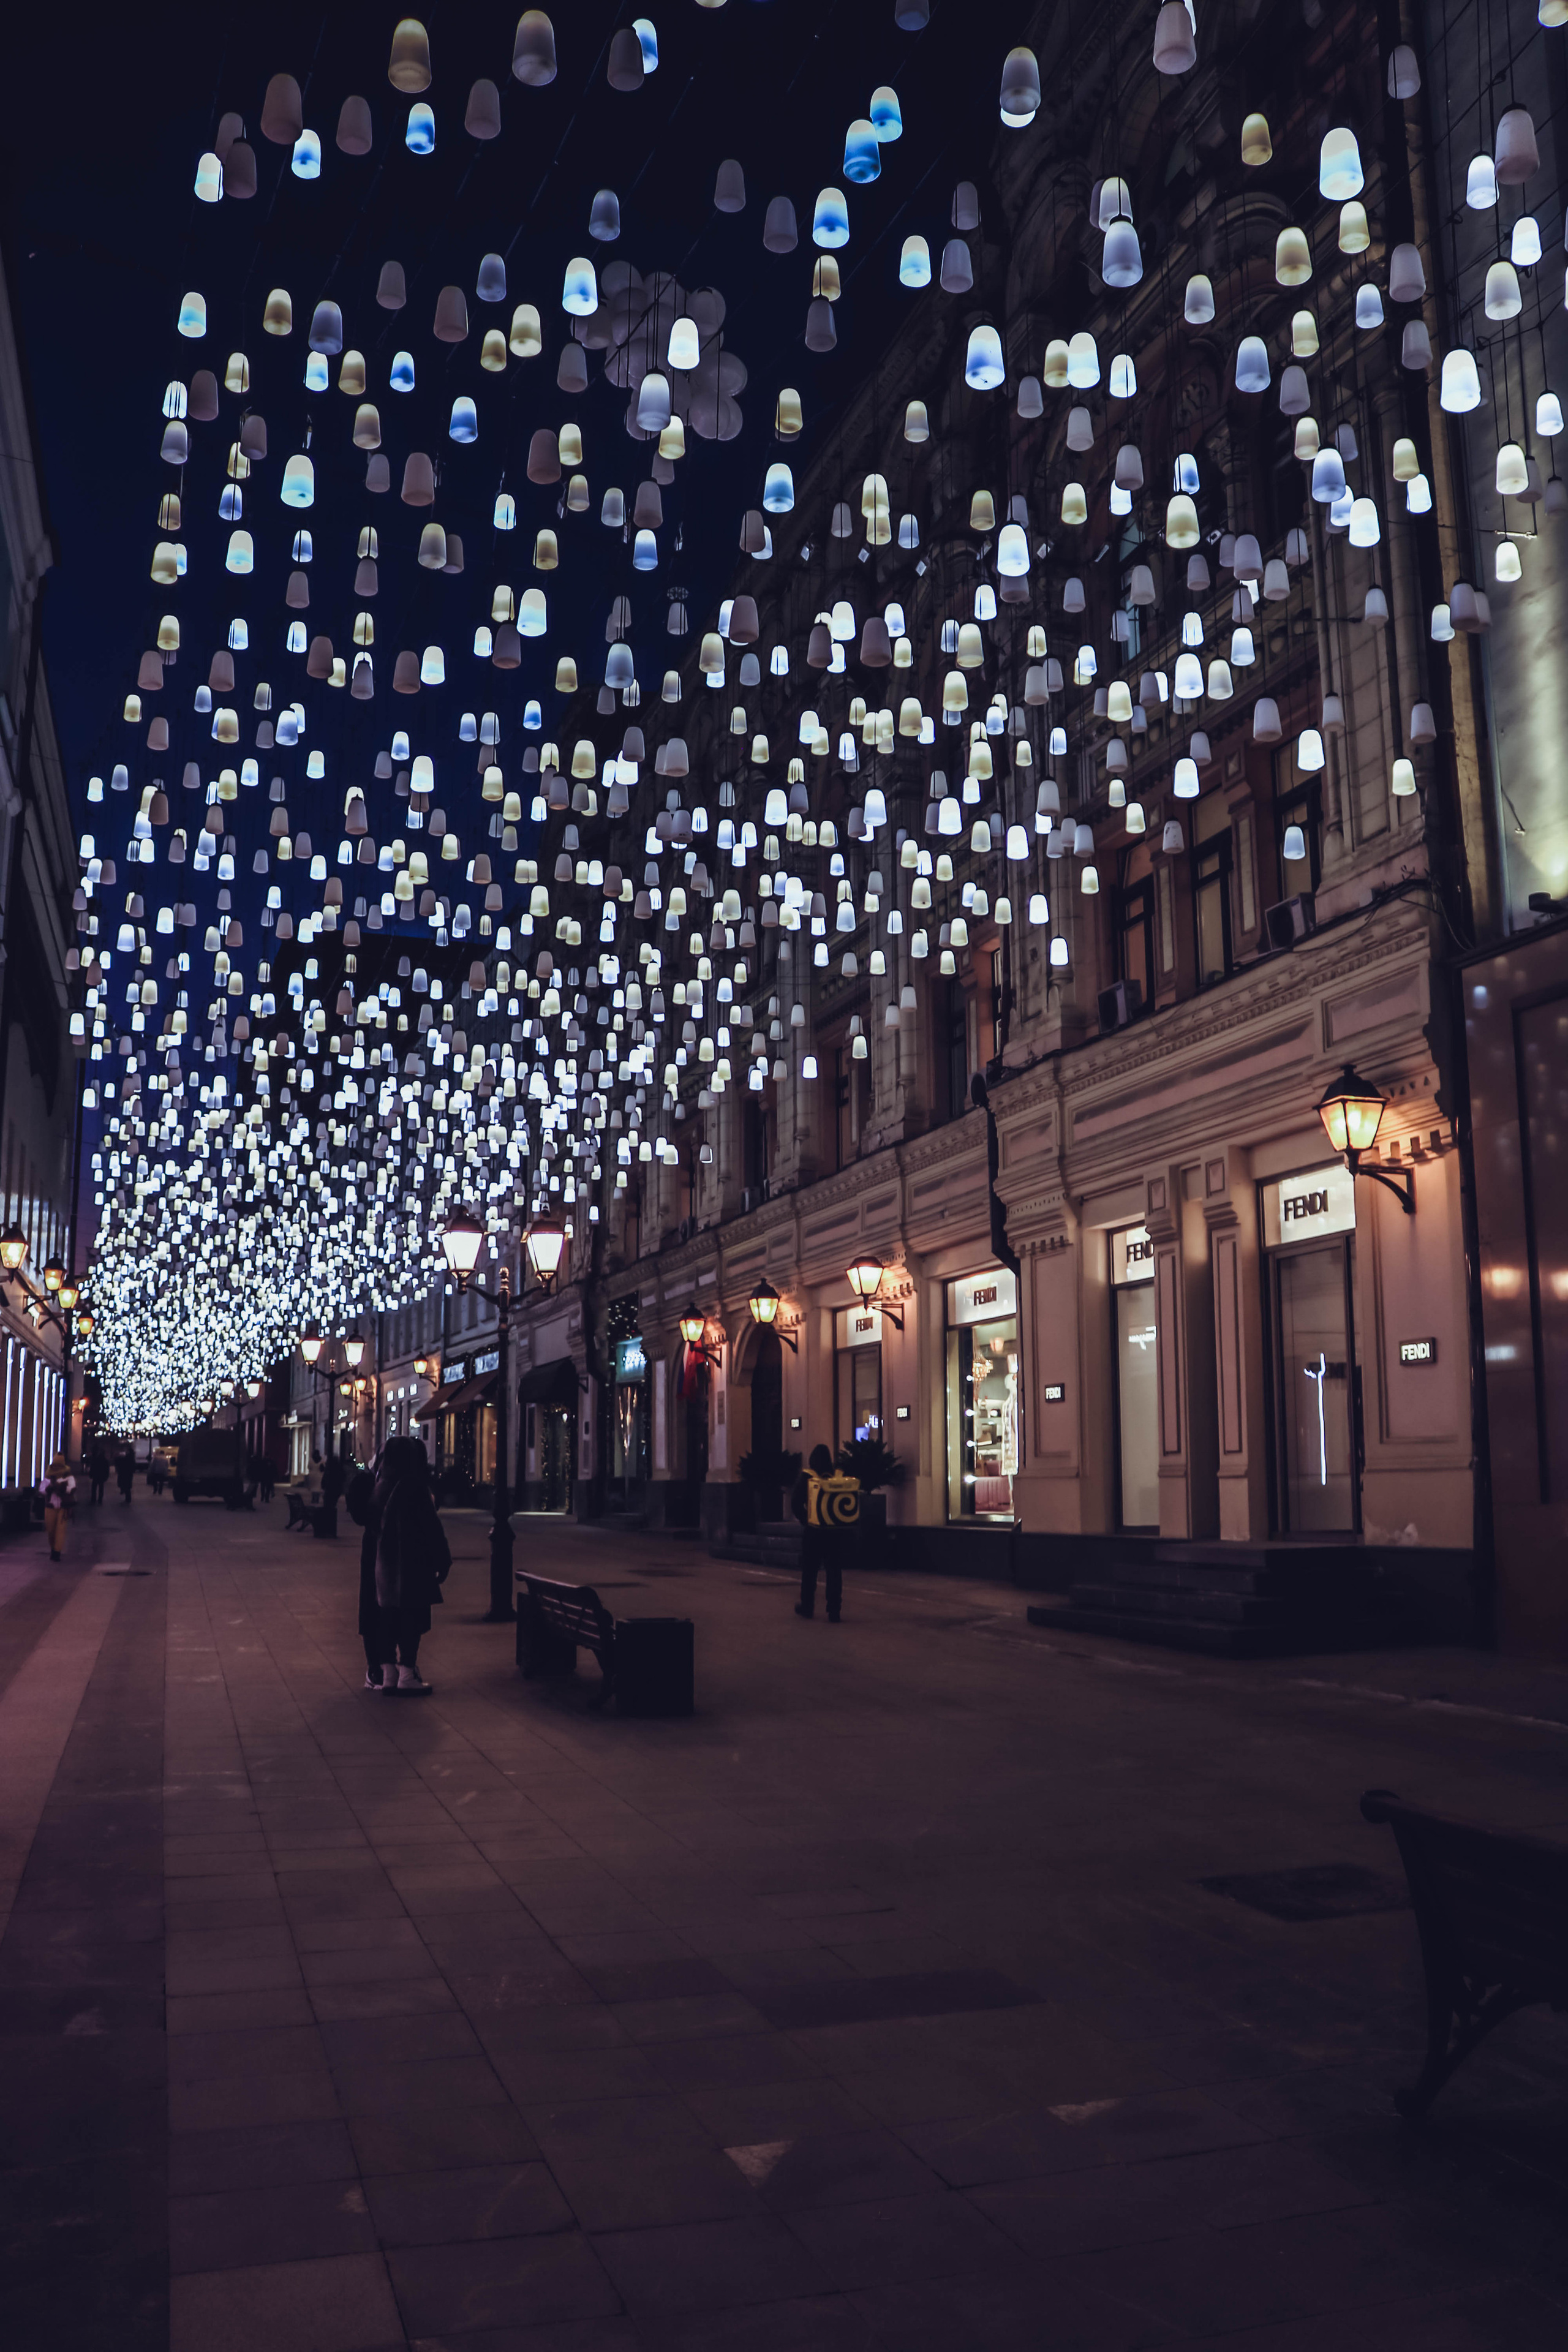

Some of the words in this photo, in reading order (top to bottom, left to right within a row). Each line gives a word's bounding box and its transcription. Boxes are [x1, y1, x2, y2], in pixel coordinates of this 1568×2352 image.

[1284, 1189, 1329, 1221] FENDI
[1126, 1240, 1155, 1263] FEND
[974, 1286, 997, 1306] FENDI
[1401, 1342, 1430, 1360] FENDI
